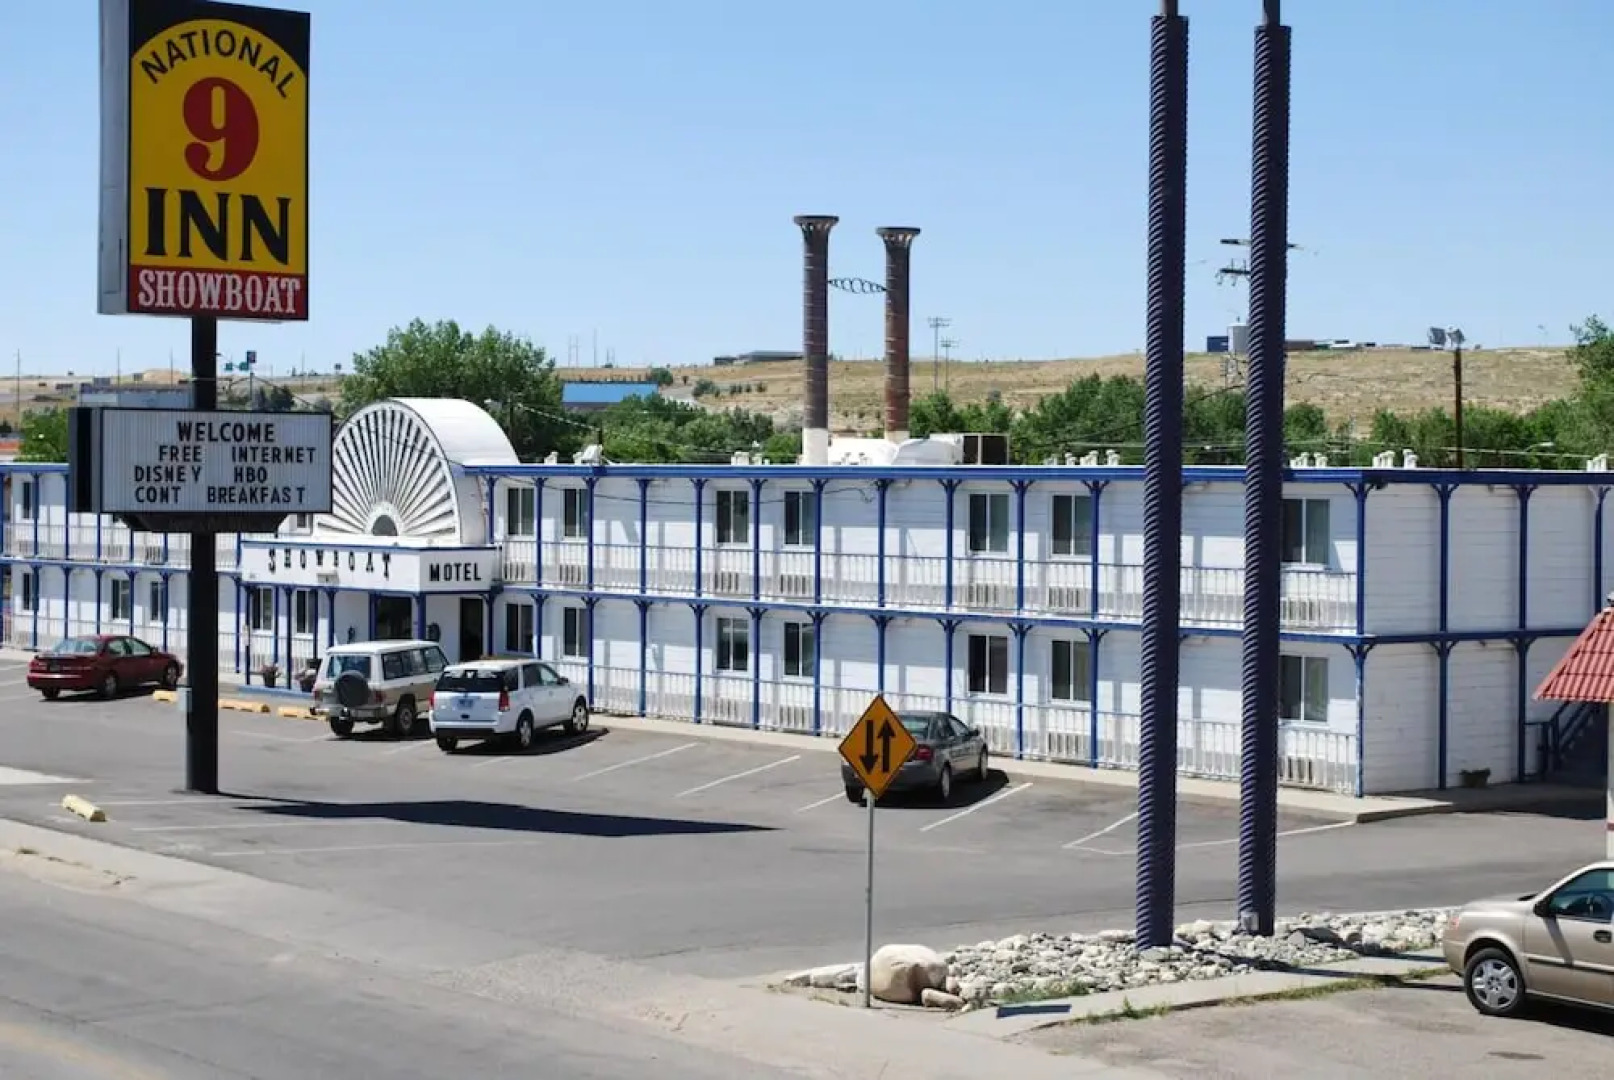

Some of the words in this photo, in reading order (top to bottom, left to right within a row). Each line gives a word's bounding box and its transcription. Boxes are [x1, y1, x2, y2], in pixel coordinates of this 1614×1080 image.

[141, 29, 295, 98] NATIONAL
[182, 76, 259, 182] 9
[144, 187, 291, 265] INN
[138, 269, 301, 314] SHOWBOAT
[177, 421, 275, 443] WELCOME
[158, 445, 202, 462] FREE
[231, 446, 316, 464] INTERNET
[134, 466, 202, 483] DISNEY
[233, 466, 268, 484] HBO
[134, 486, 181, 503] CONT
[207, 486, 306, 504] BREAKFAST
[429, 563, 482, 582] MOTEL
